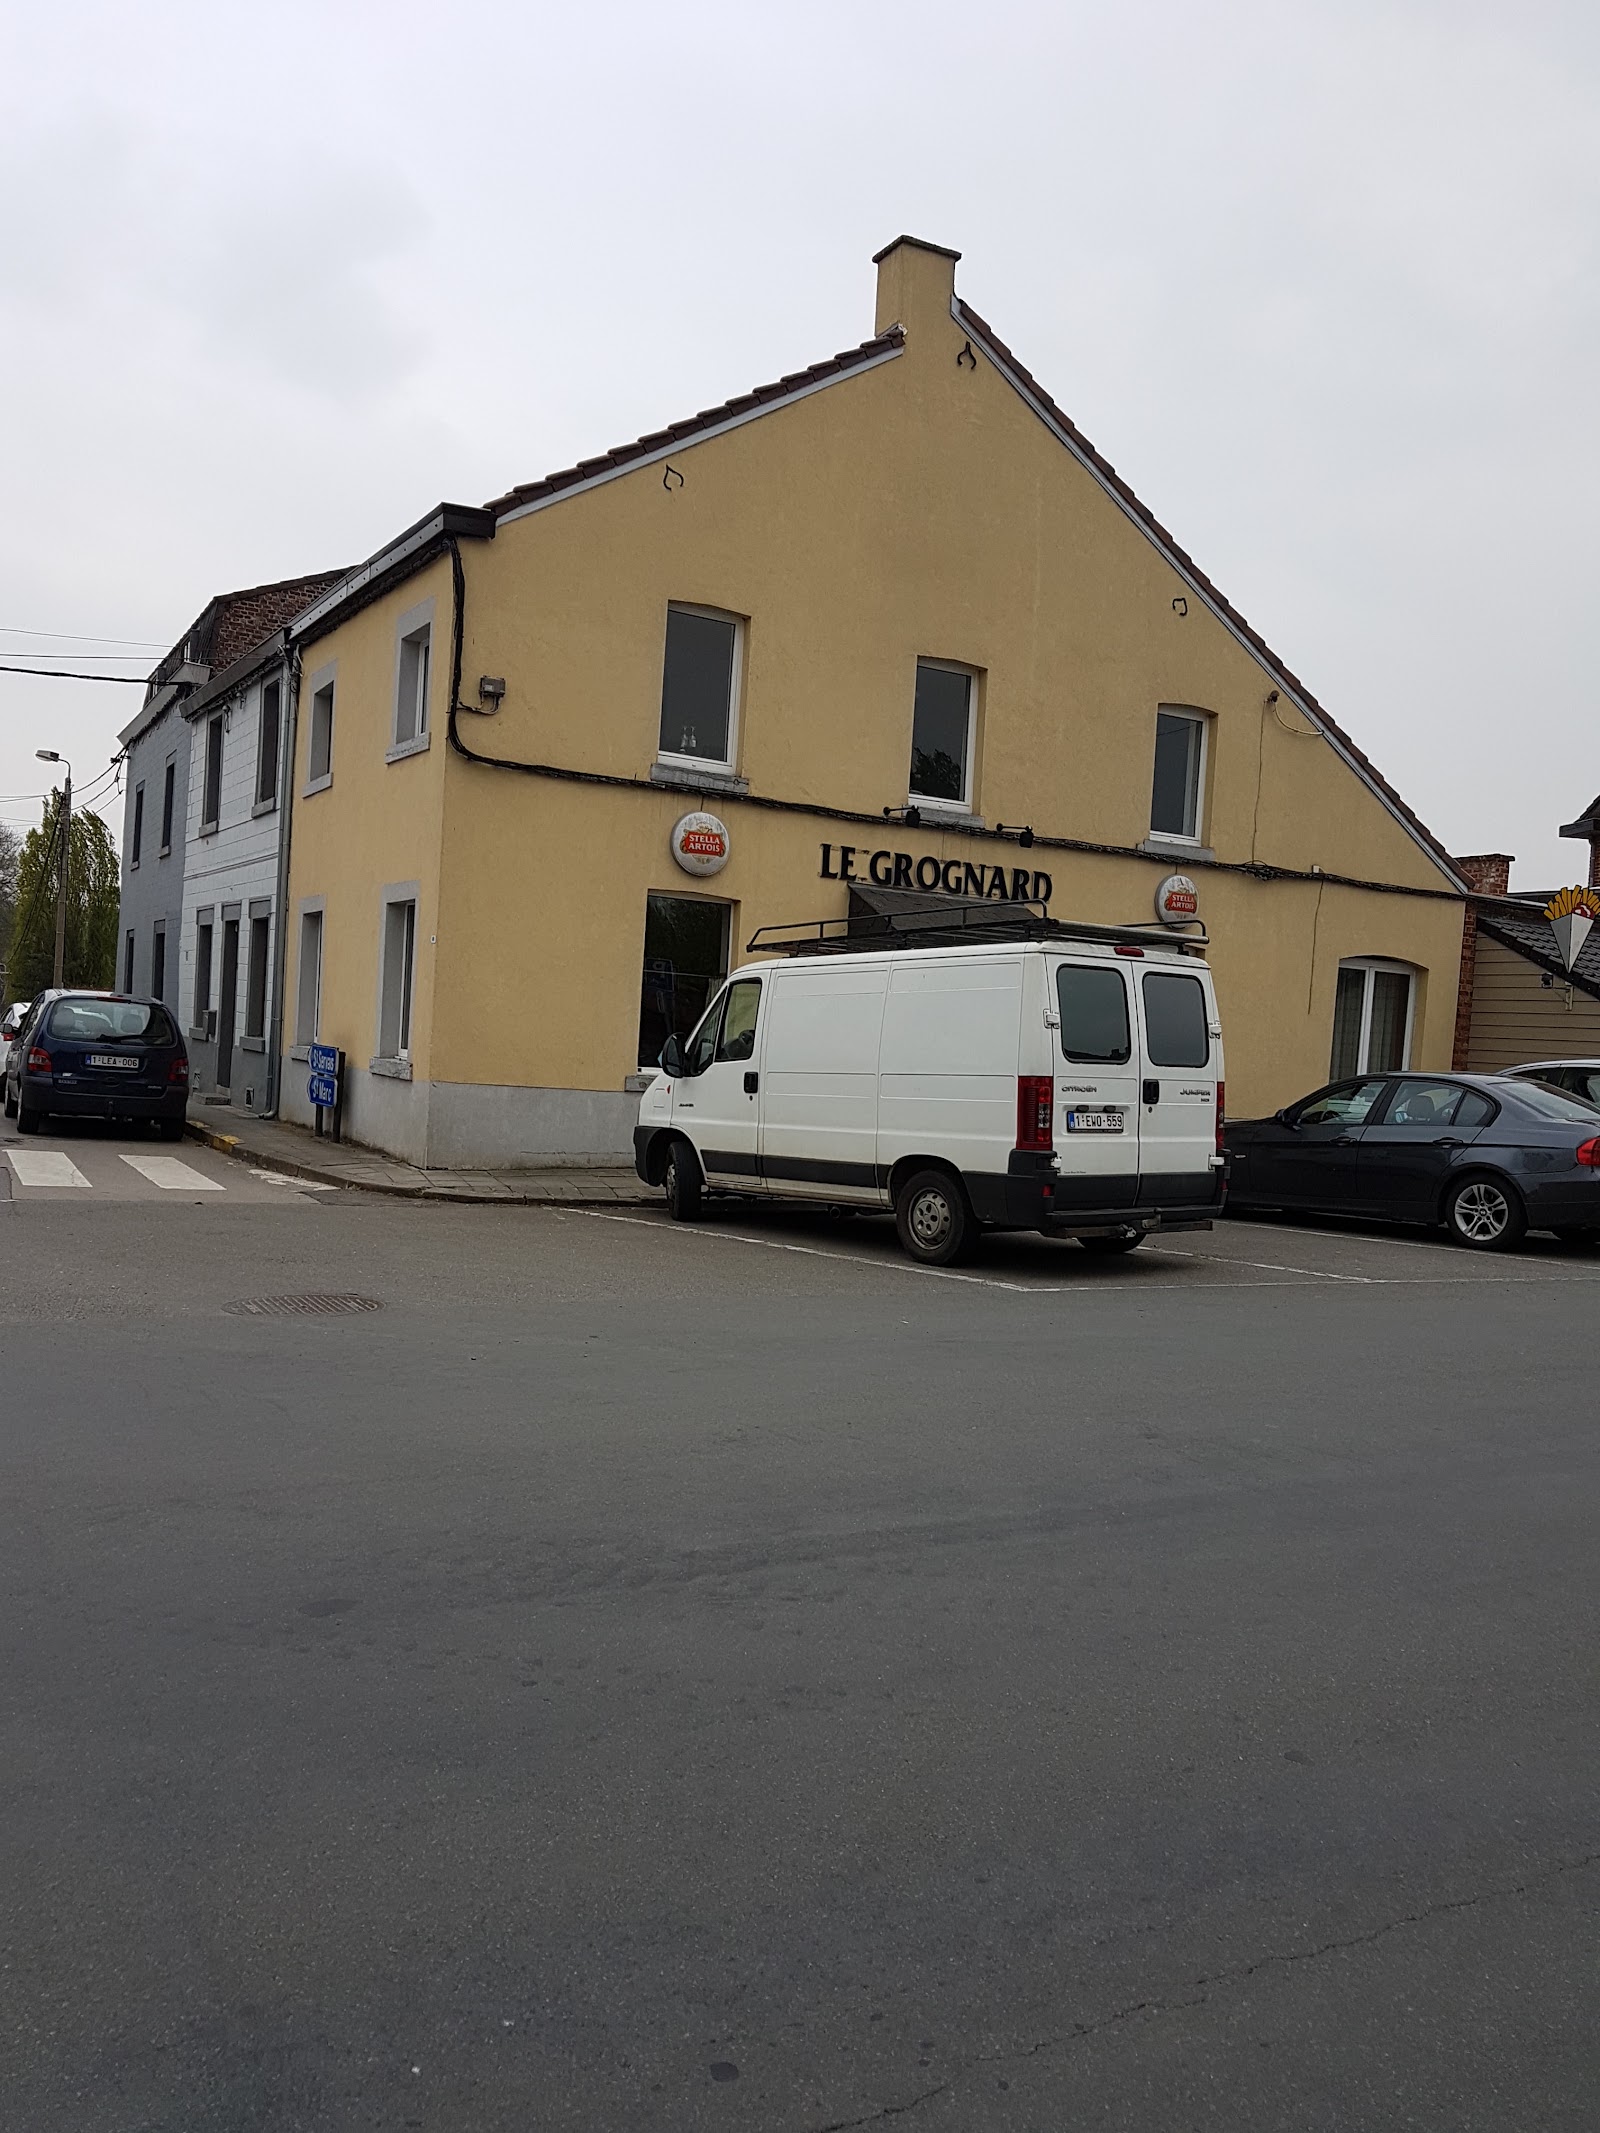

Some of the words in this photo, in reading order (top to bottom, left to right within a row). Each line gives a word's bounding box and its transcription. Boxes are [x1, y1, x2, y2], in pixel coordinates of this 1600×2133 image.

[688, 834, 720, 844] STELLA
[688, 842, 721, 853] ARTOIS
[819, 843, 858, 881] LE
[869, 850, 1053, 904] GROGNARD
[1172, 894, 1195, 903] STELLA
[1171, 901, 1195, 910] ARTOIS
[319, 1081, 332, 1103] Marc
